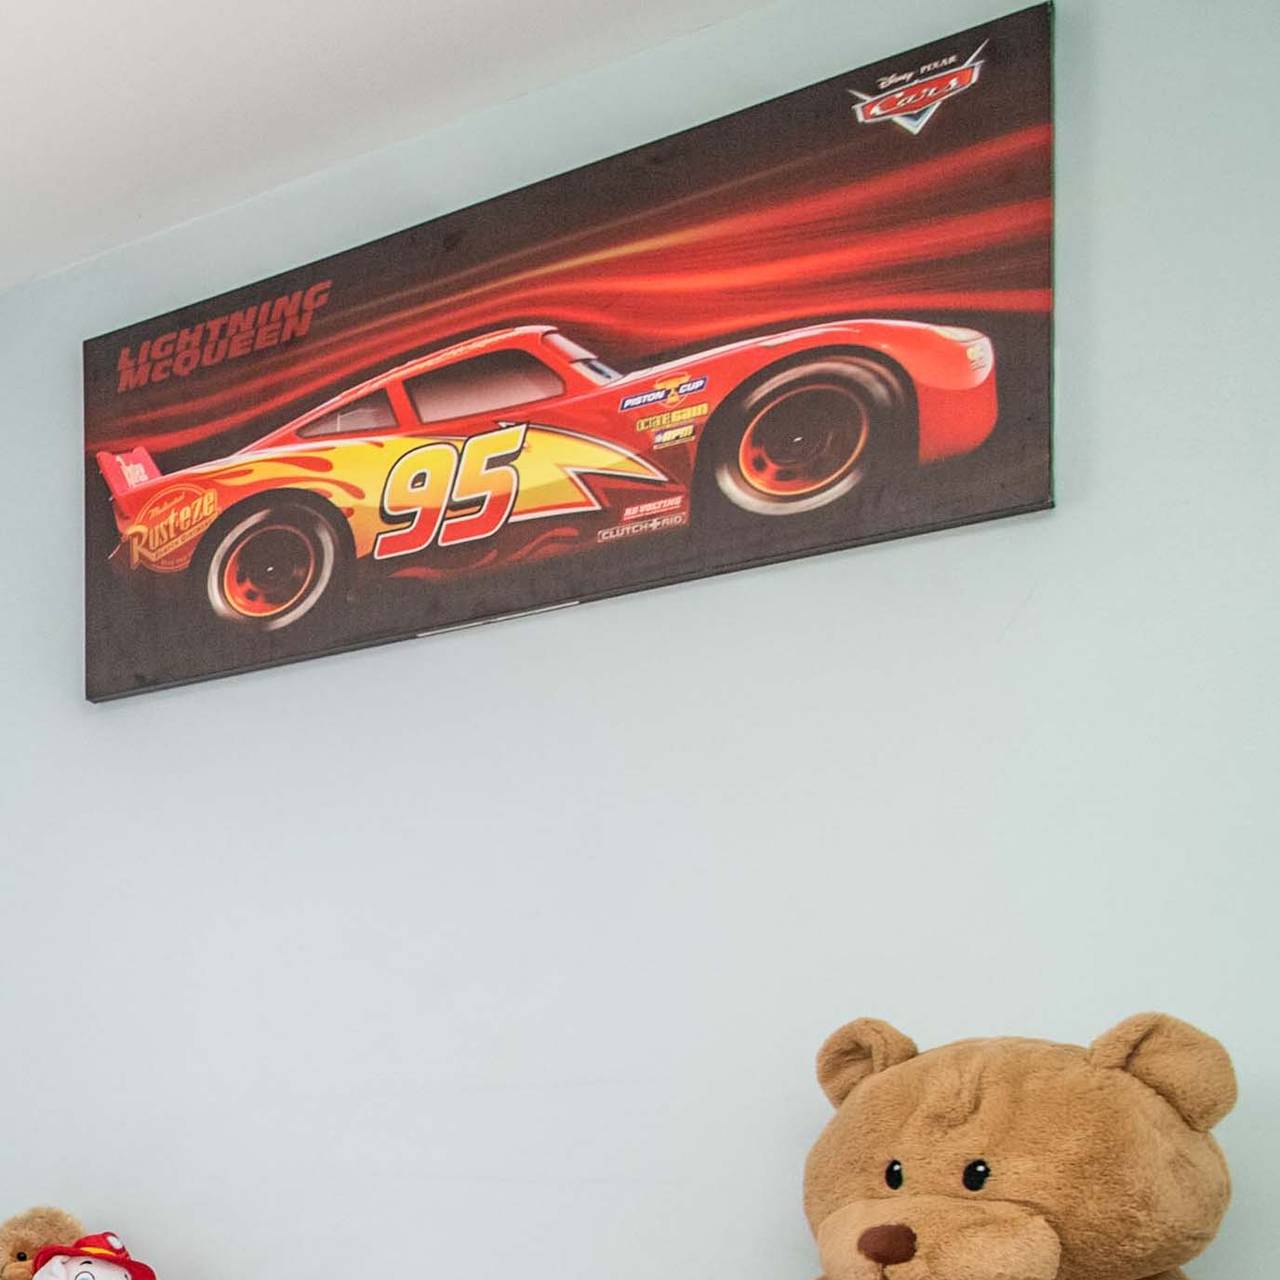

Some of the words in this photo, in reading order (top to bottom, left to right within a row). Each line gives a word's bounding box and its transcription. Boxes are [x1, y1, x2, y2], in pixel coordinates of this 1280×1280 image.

[876, 71, 915, 89] Disney
[920, 55, 958, 74] PIXAR
[869, 77, 959, 116] Cars
[118, 280, 333, 371] LIGHTNING
[623, 390, 667, 409] PISTON
[678, 379, 705, 394] CUP
[373, 422, 529, 561] 95
